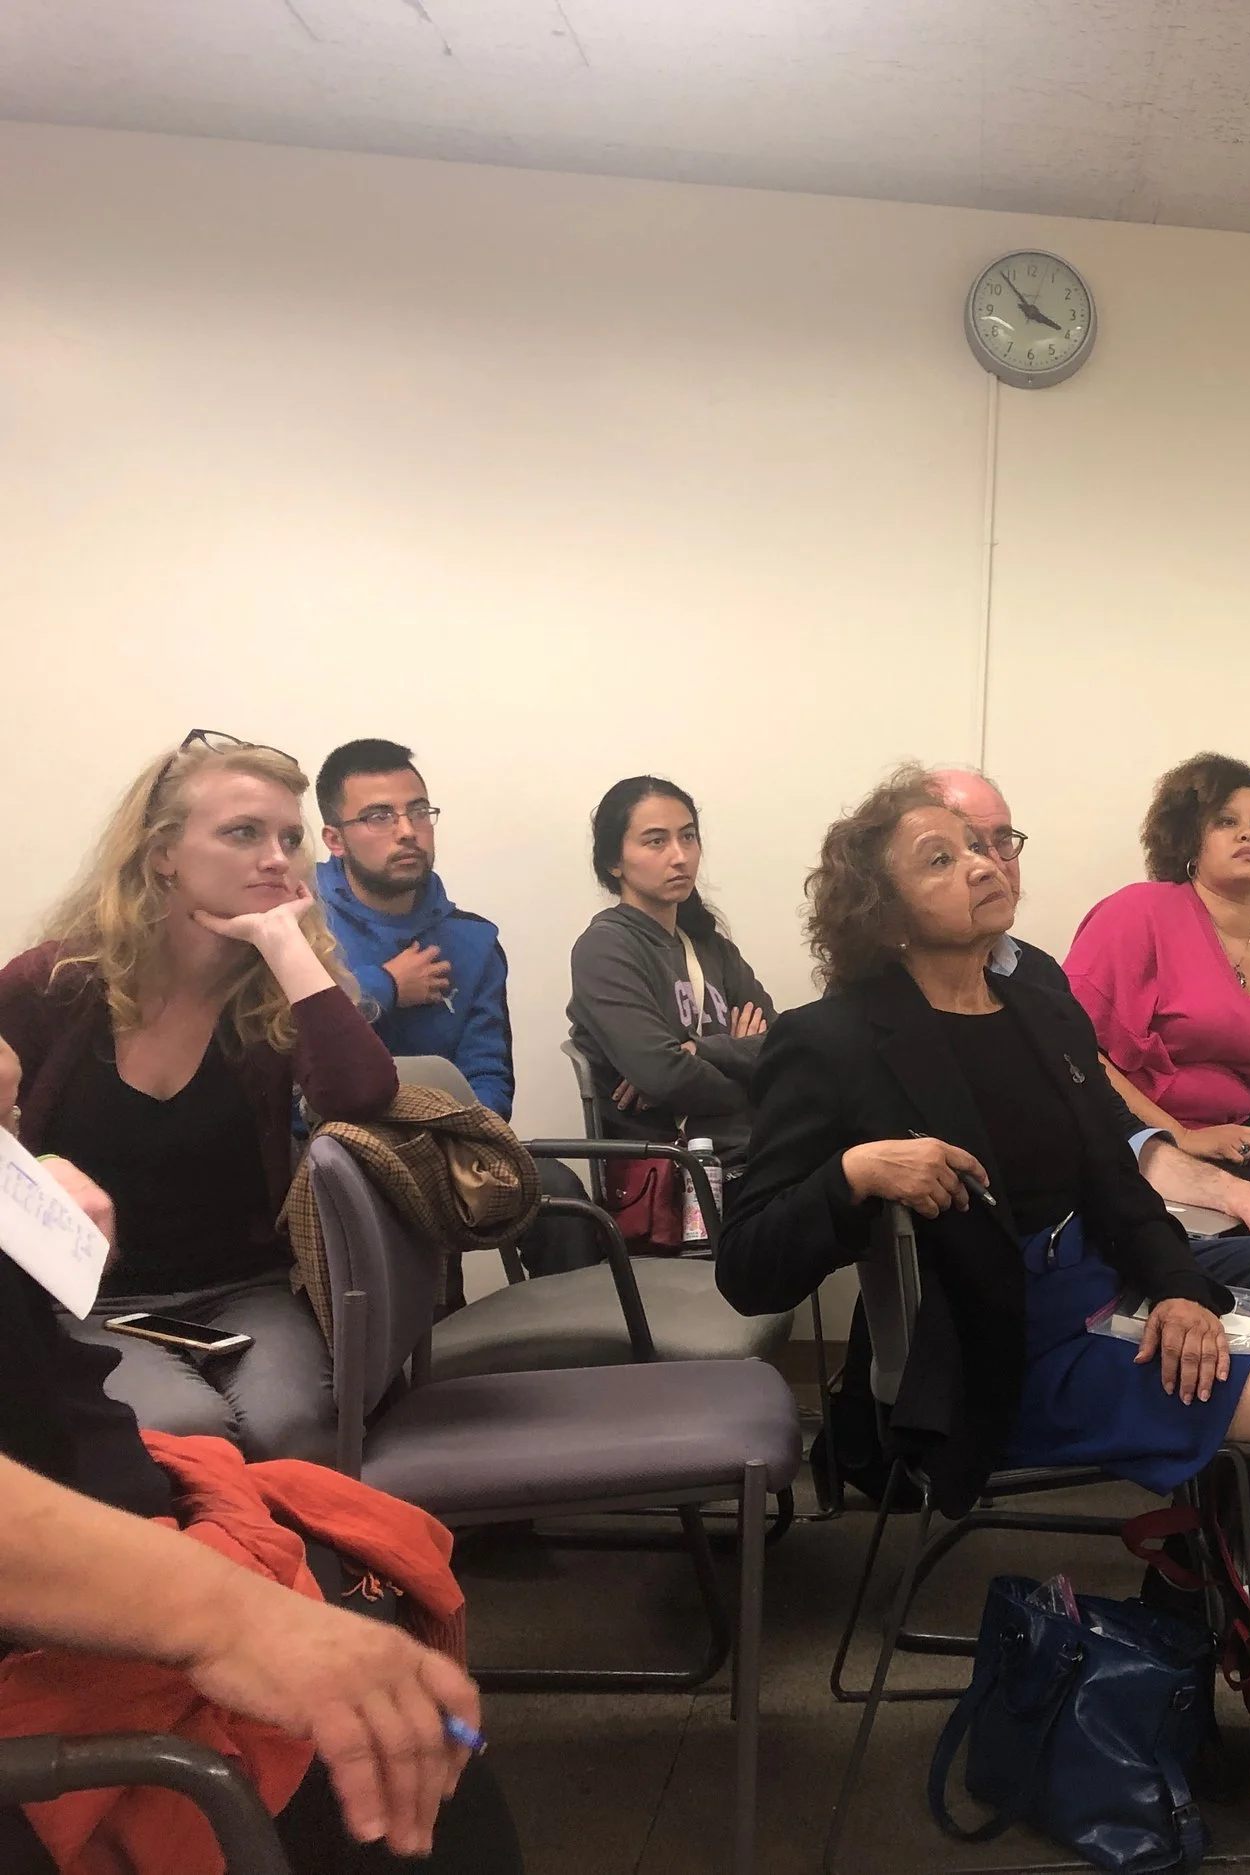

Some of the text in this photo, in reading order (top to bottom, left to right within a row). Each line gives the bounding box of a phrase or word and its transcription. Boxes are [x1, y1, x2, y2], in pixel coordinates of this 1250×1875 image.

[1006, 270, 1016, 280] 11
[1027, 265, 1038, 277] 12
[1051, 272, 1054, 283] 1
[989, 284, 1002, 296] 10
[1064, 288, 1072, 300] 2
[986, 305, 994, 315] 9
[1070, 310, 1076, 320] 3
[992, 326, 998, 336] 8
[1064, 330, 1071, 339] 4
[1007, 341, 1013, 353] 7
[1048, 344, 1055, 355] 5
[1027, 349, 1035, 360] 6
